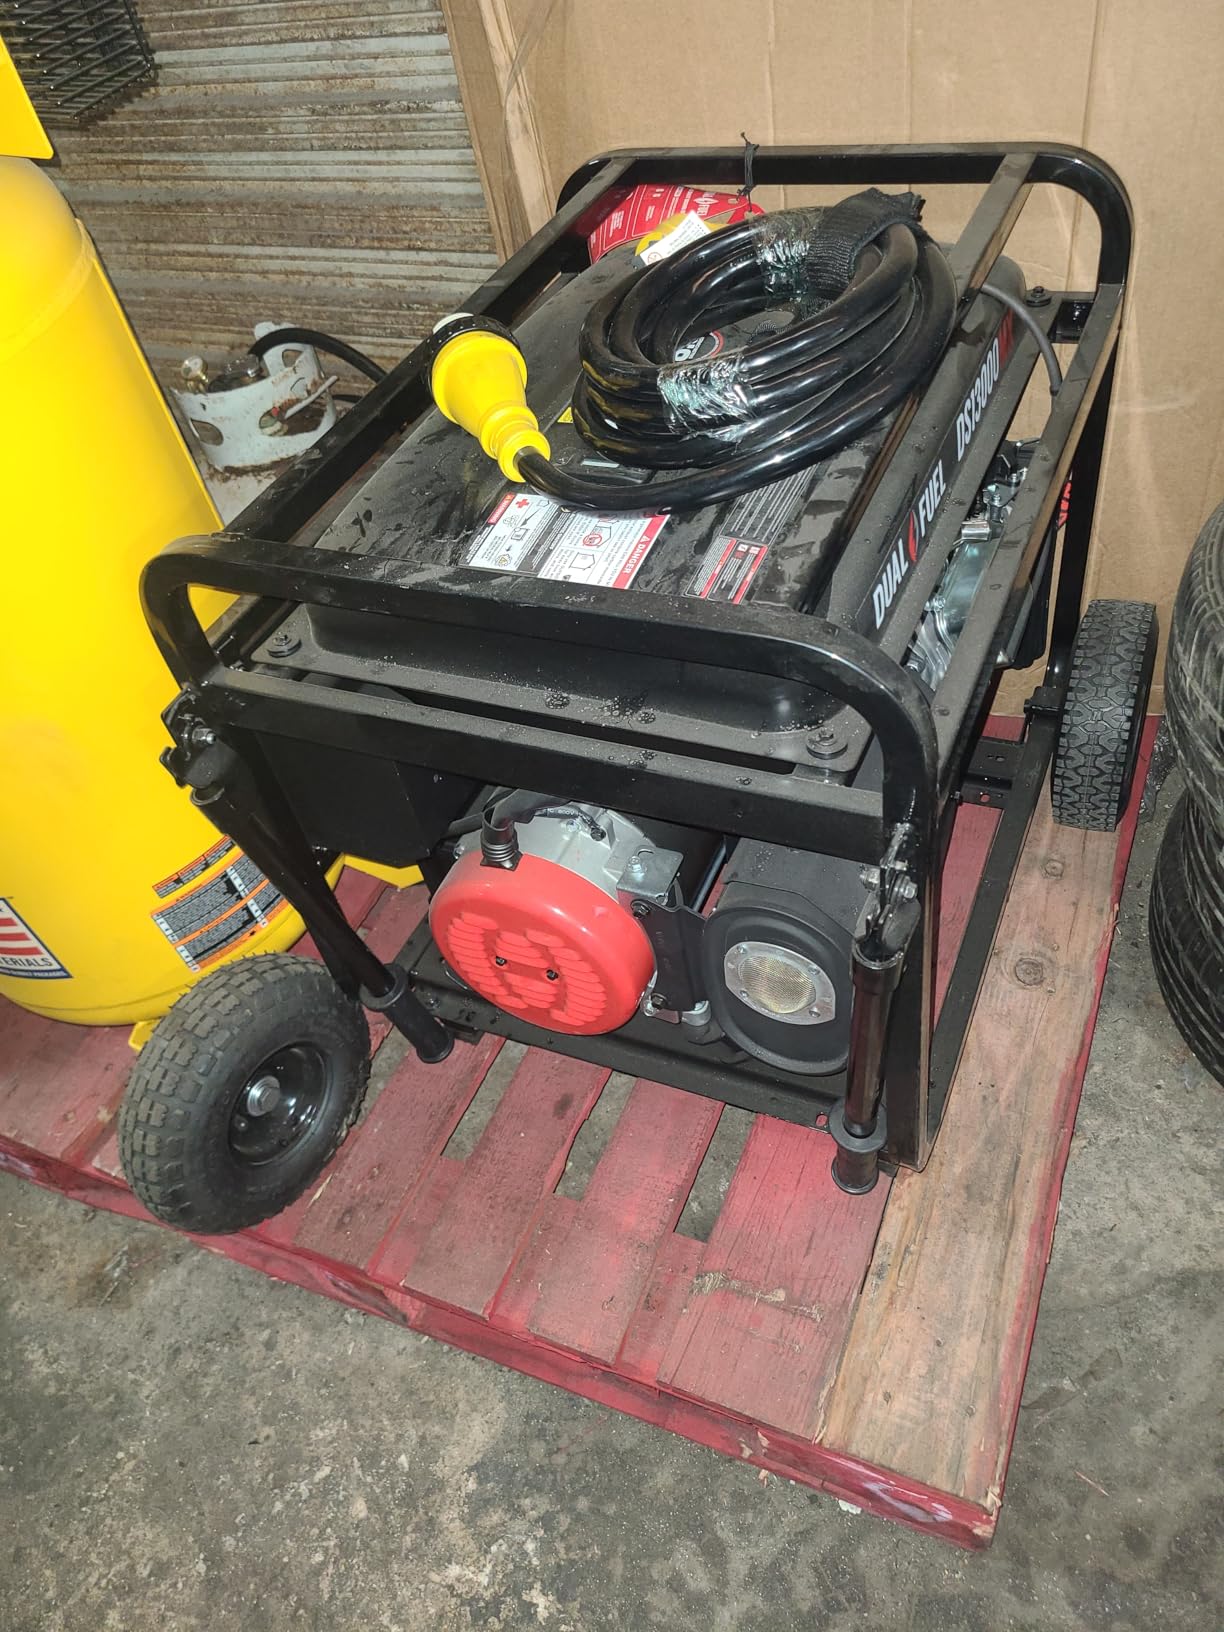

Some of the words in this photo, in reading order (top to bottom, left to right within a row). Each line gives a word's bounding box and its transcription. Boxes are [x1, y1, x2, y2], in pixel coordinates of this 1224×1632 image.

[622, 544, 646, 574] DANGER
[872, 538, 909, 629] DUAL
[918, 460, 946, 536] FUEL
